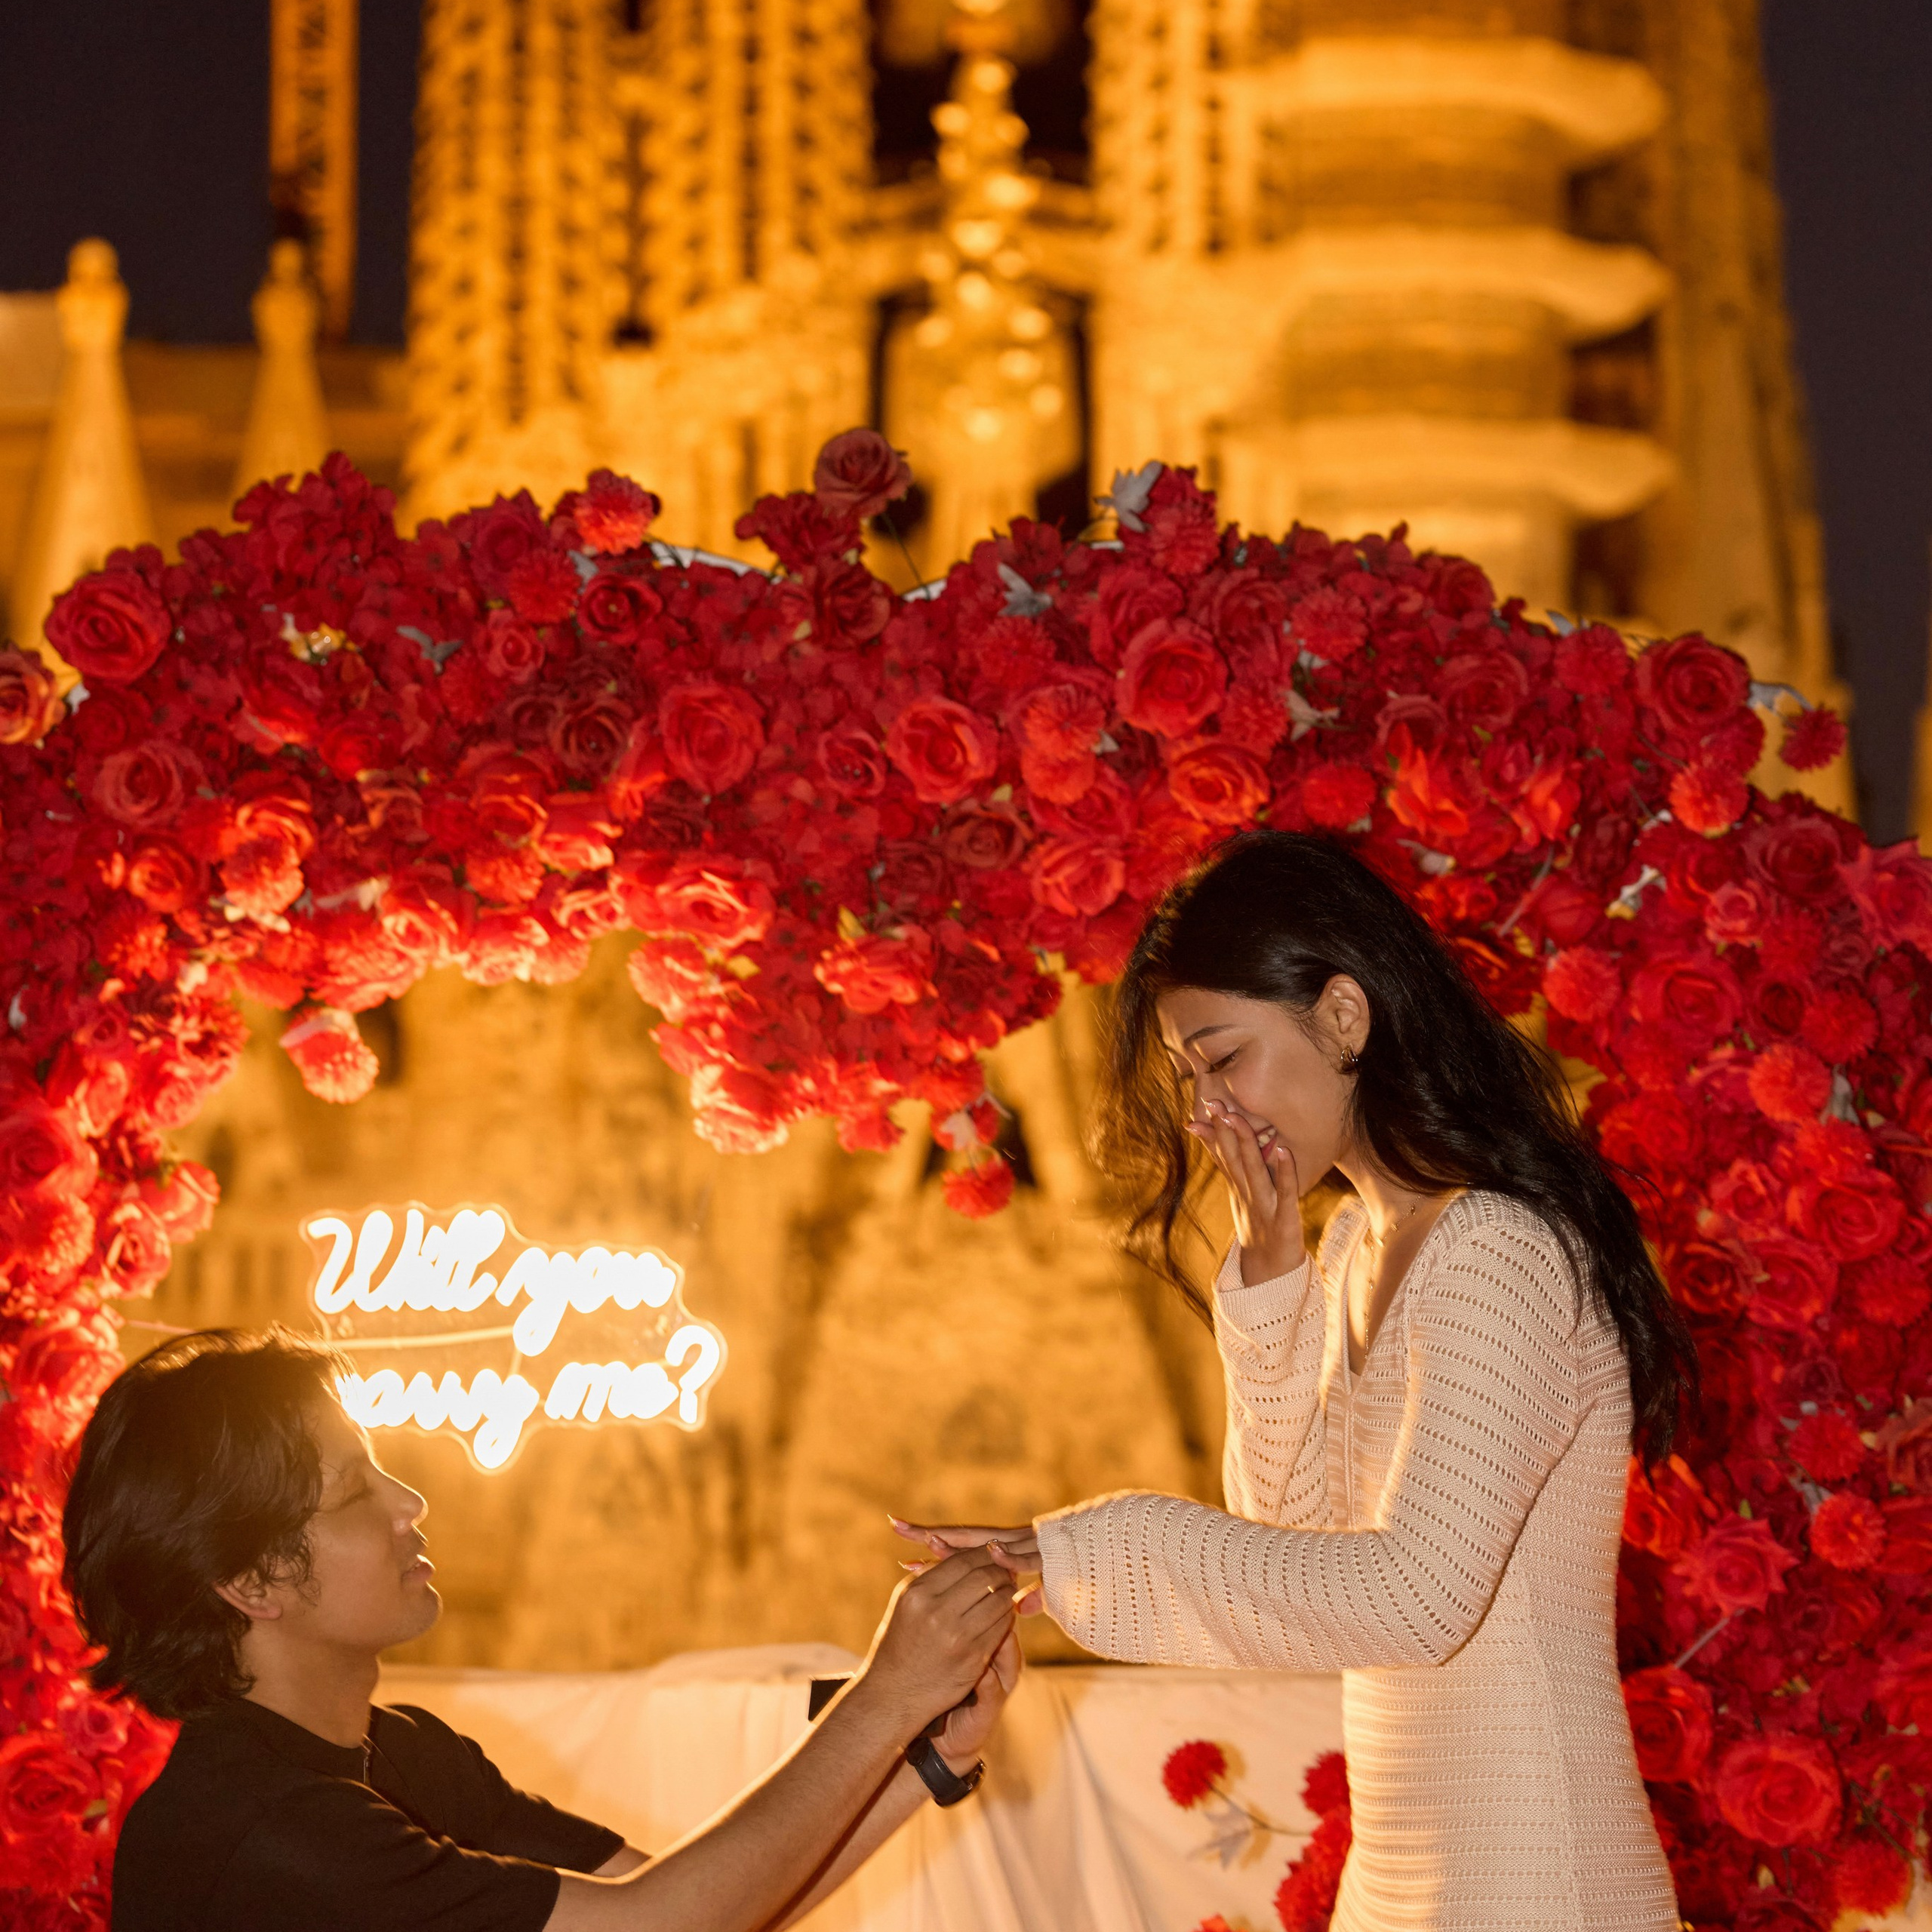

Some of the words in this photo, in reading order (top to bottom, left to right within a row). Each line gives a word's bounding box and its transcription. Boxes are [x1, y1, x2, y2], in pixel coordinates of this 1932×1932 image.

[307, 1209, 506, 1313] Will
[495, 1246, 677, 1357] you
[335, 1368, 540, 1469] arry
[543, 1324, 721, 1424] me?
